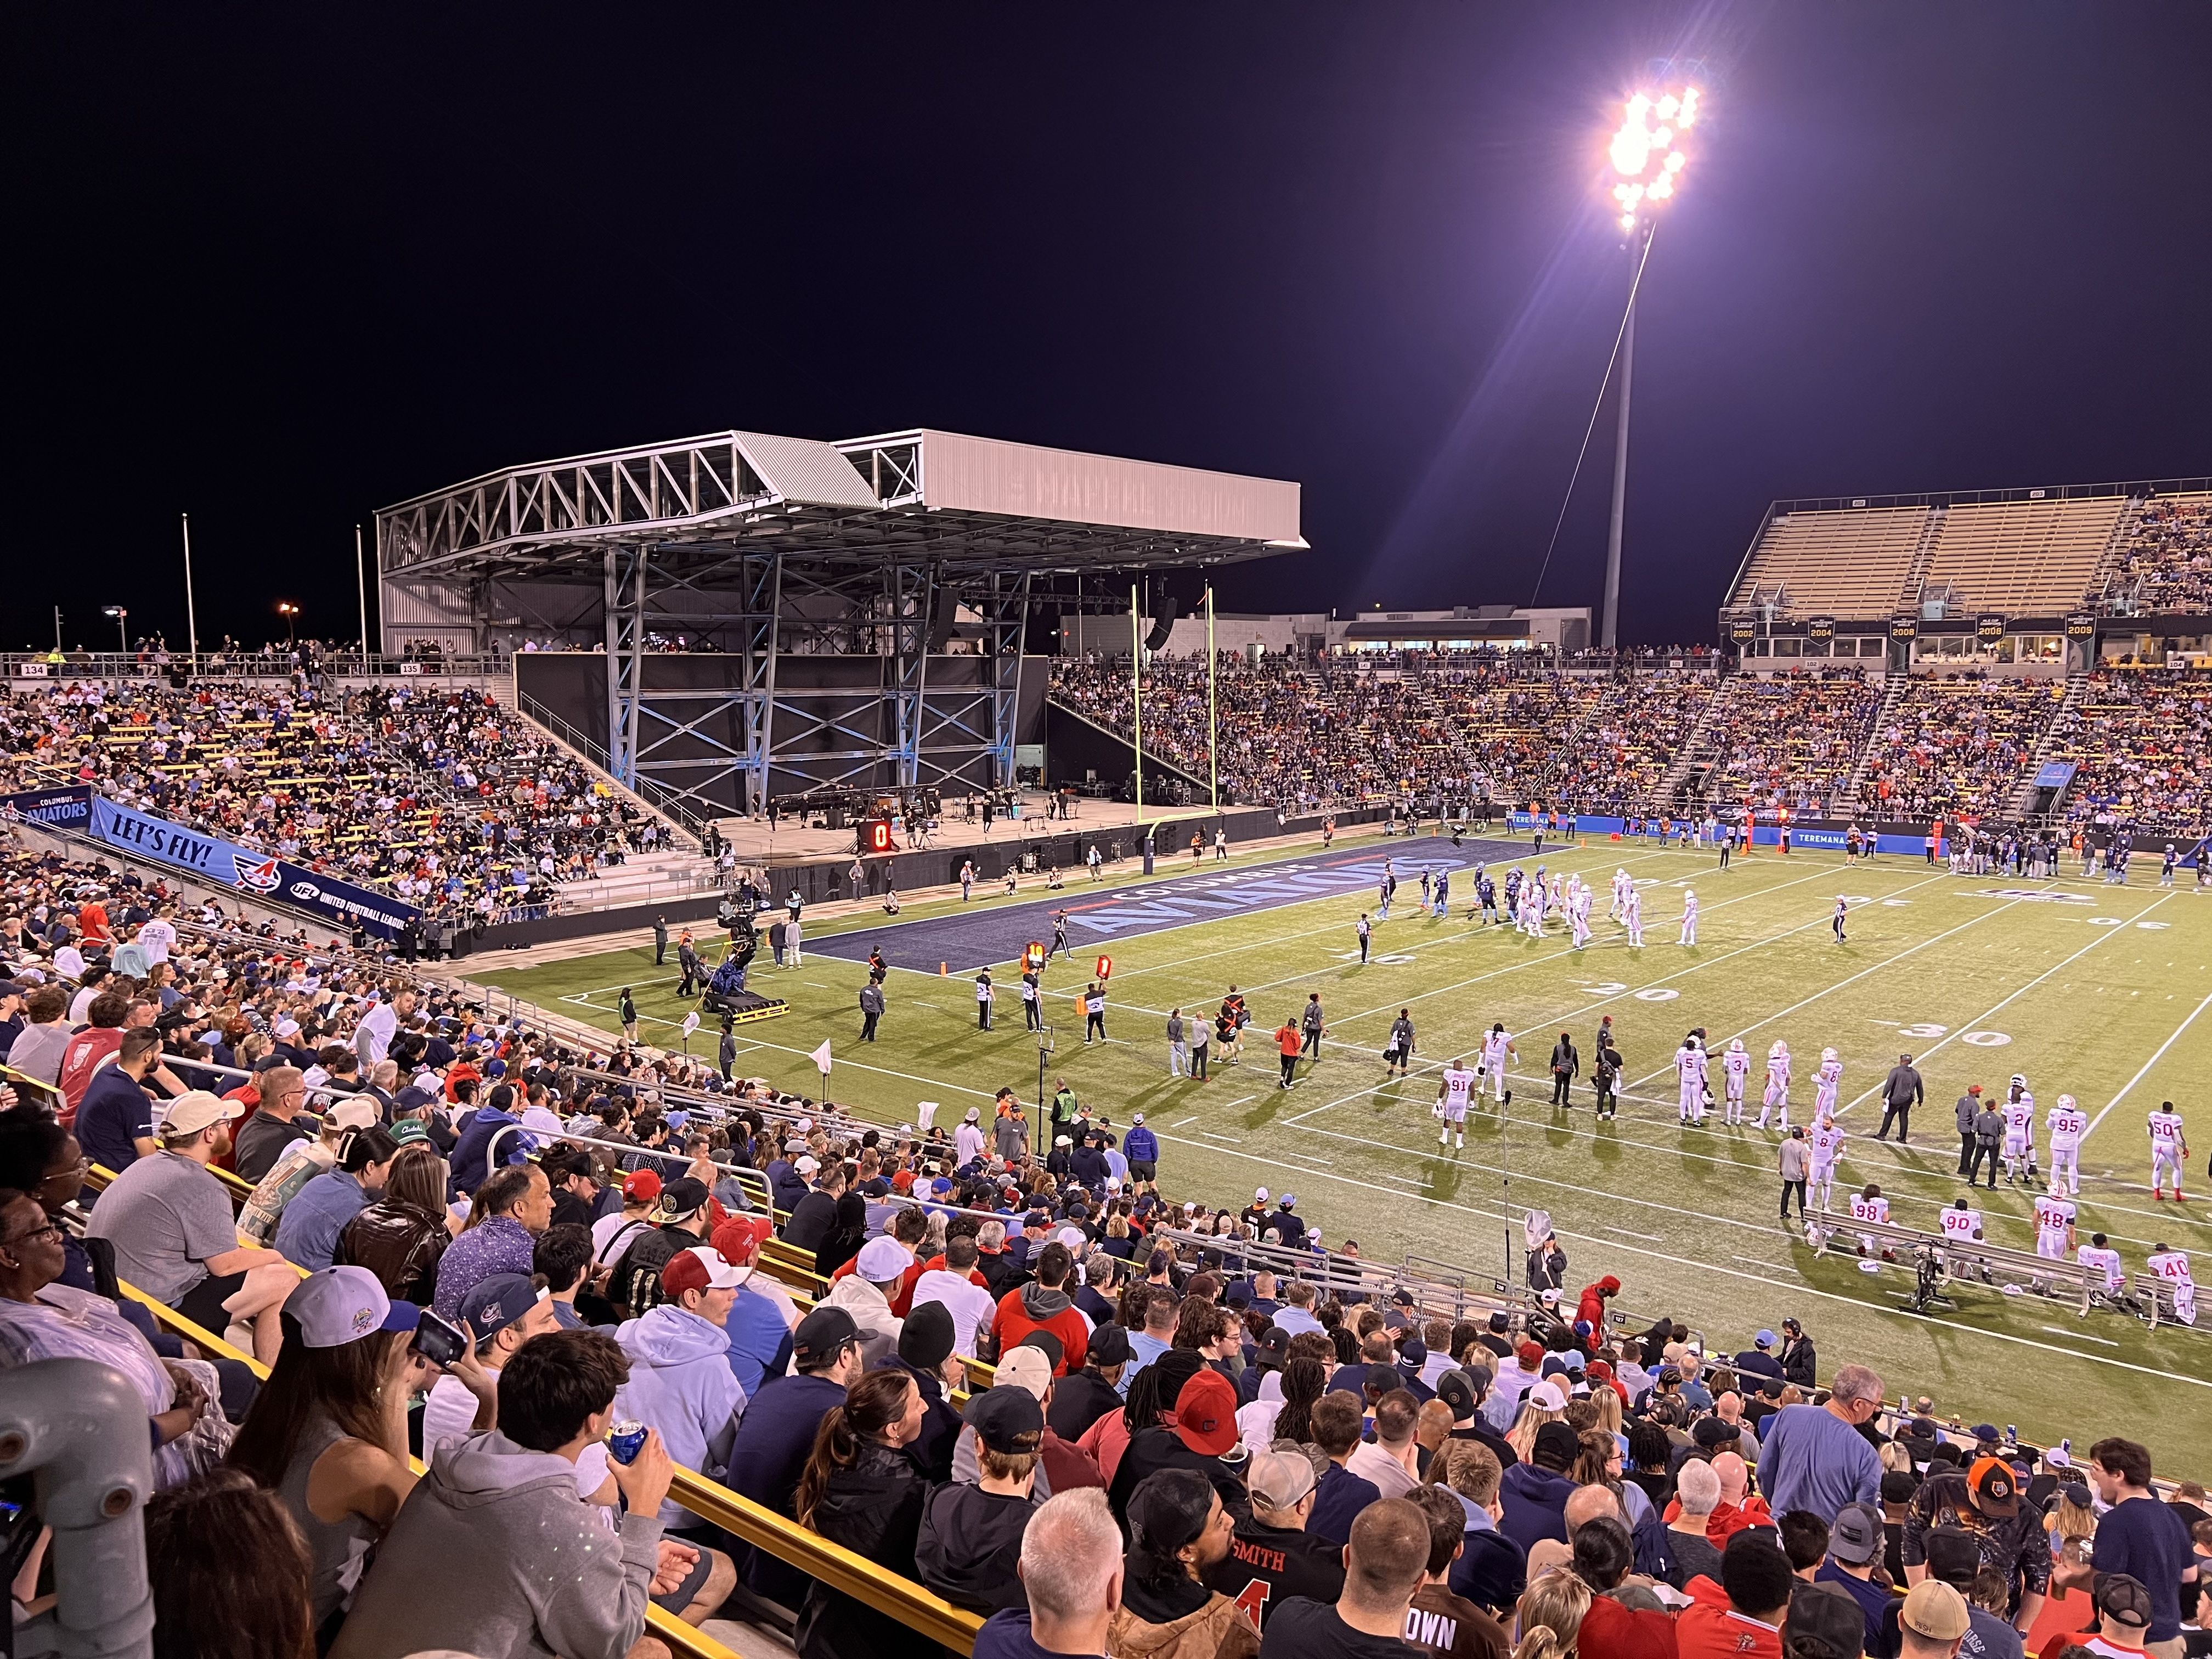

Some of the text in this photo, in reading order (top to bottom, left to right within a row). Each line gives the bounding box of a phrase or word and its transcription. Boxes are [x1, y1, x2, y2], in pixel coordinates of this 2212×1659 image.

[1978, 627, 2002, 635] 2008
[2068, 626, 2092, 634] 2009
[25, 666, 43, 674] 134
[40, 795, 74, 806] COLUMBUS
[26, 802, 88, 825] AVIATORS
[1512, 816, 1549, 825] TERENA
[111, 813, 213, 867] LET'S FLY!
[875, 825, 887, 848] 0
[1798, 834, 1844, 844] TEREMANA
[1111, 864, 1318, 901] COLUMBUS
[292, 883, 315, 898] UFL
[1066, 856, 1467, 934] AVIATORS
[319, 891, 346, 909] UNITED
[345, 901, 381, 922] FOOTBALL
[1029, 944, 1043, 956] 10
[1493, 1037, 1500, 1048] 7
[1686, 1058, 1693, 1068] 5
[1734, 1060, 1742, 1071] 3
[1452, 1080, 1466, 1092] 91
[2014, 1114, 2023, 1126] 2
[2058, 1119, 2079, 1132] 95
[2153, 1121, 2173, 1137] 50
[1820, 1138, 1828, 1147] 8
[1857, 1205, 1877, 1221] 98
[2041, 1210, 2064, 1228] 48
[1946, 1216, 1970, 1230] 90
[2165, 1260, 2188, 1277] 40
[1203, 1419, 1216, 1432] C
[1233, 1538, 1286, 1572] SMITH
[1914, 1620, 1932, 1633] IRISH
